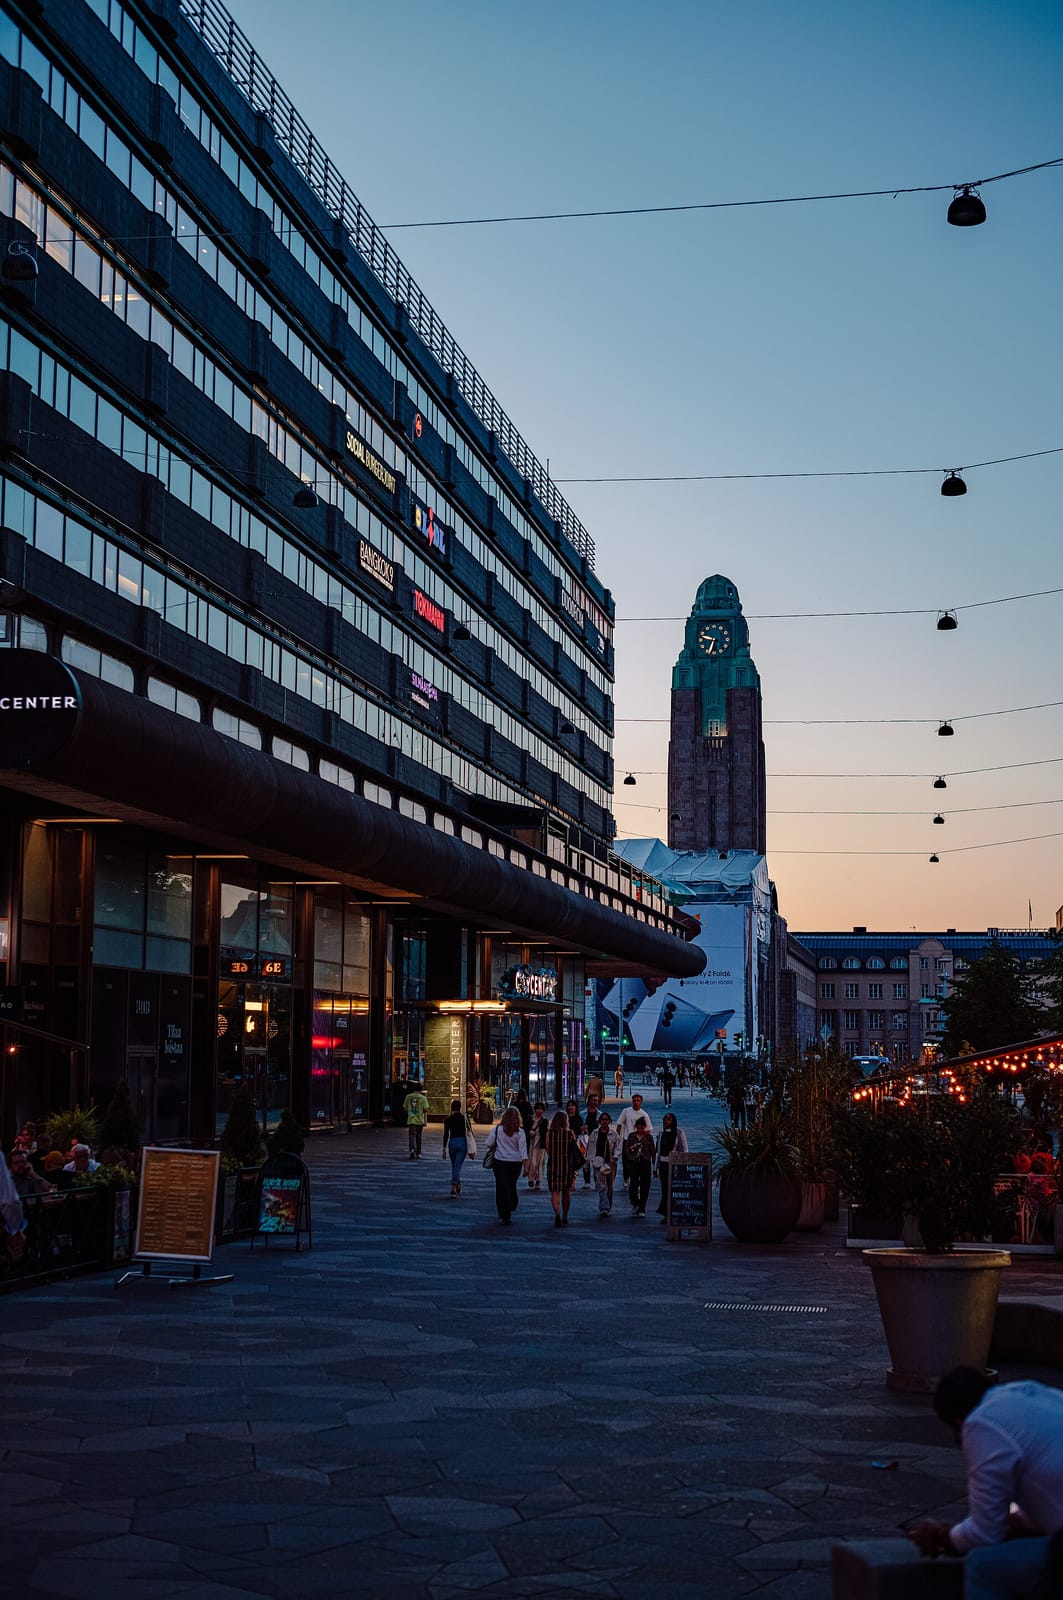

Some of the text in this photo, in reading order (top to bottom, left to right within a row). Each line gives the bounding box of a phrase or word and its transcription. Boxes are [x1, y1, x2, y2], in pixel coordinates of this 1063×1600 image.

[346, 431, 365, 464] SOCIAL
[0, 696, 78, 710] CENTER
[265, 962, 282, 973] 6E
[451, 1019, 461, 1101] ITYCENTER
